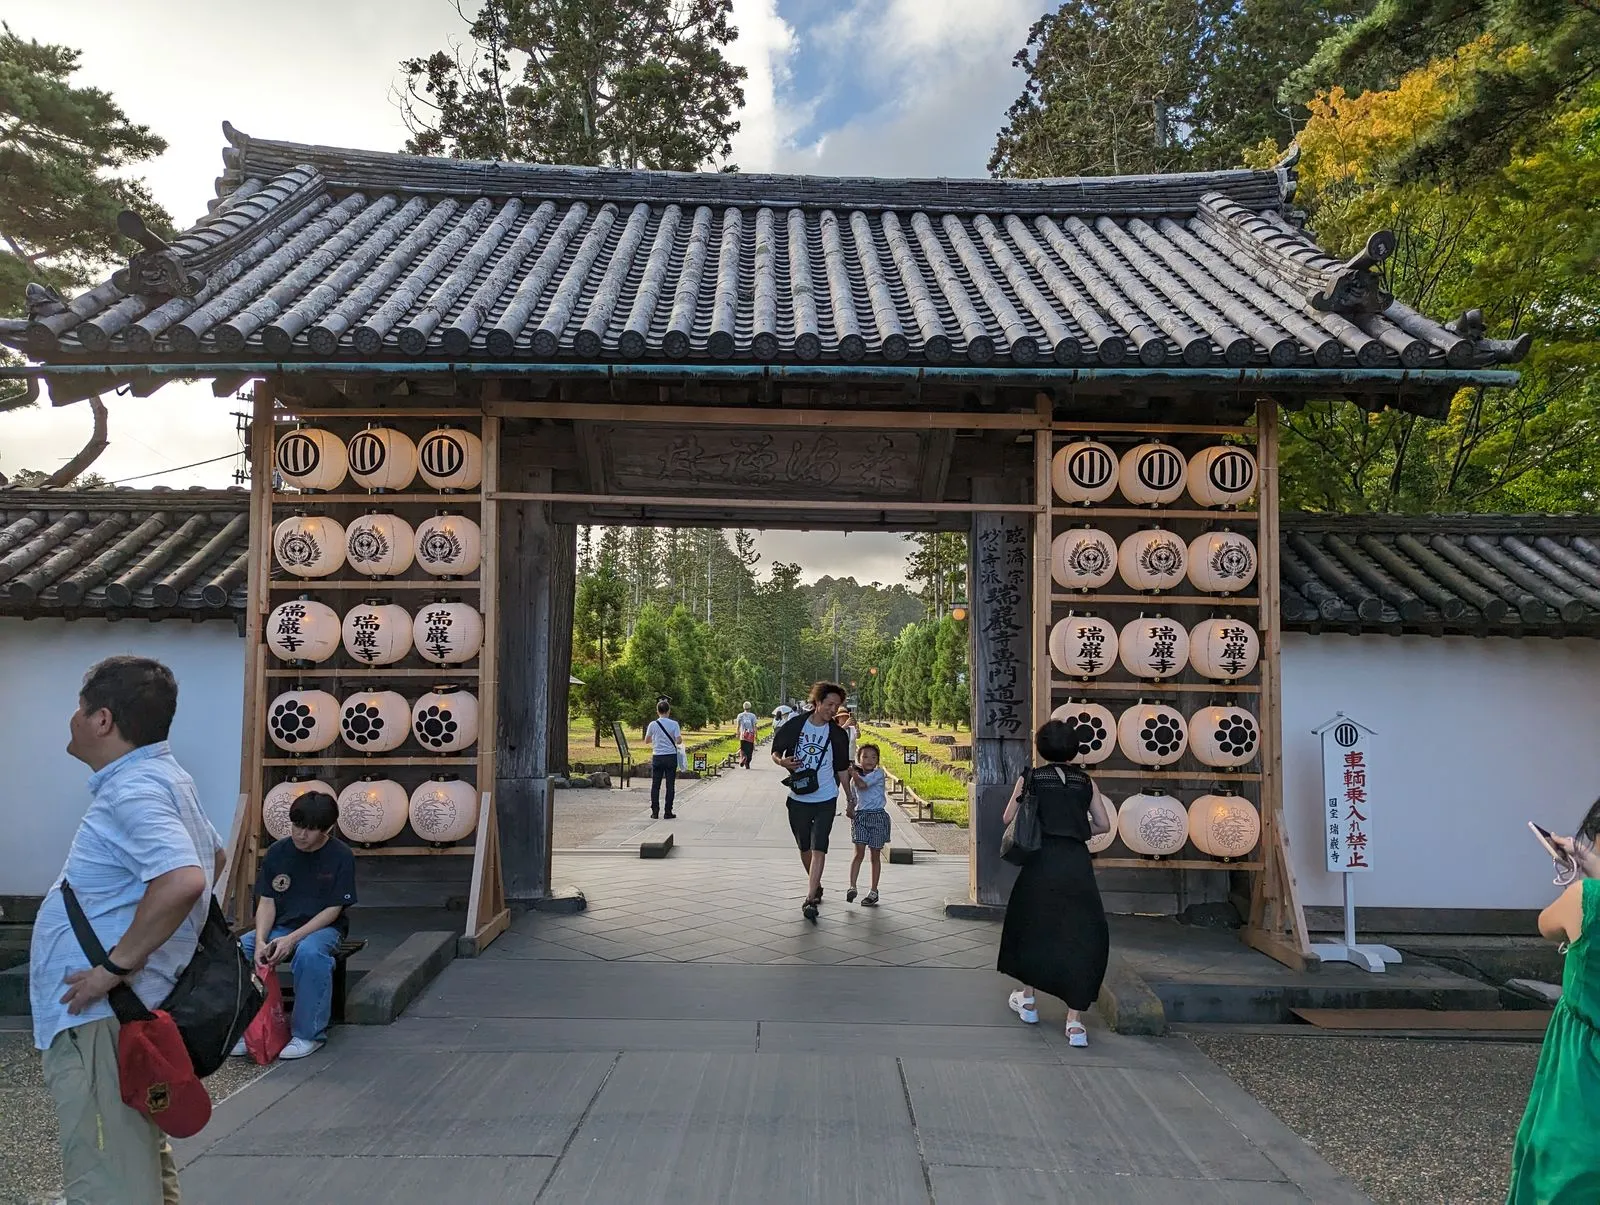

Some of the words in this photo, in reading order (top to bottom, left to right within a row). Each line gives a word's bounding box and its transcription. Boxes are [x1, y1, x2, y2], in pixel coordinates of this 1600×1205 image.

[979, 528, 1002, 585] 妙心寺派
[277, 604, 306, 652] 瑞巌寺
[352, 614, 381, 662] 瑞巌寺
[425, 610, 453, 659] 瑞巌寺
[1077, 626, 1105, 673] 瑞巌寺
[1148, 626, 1177, 673] 瑞巌寺
[1219, 627, 1248, 674] 瑞巌寺
[1328, 798, 1339, 819] 国宝
[1343, 750, 1368, 867] 車輌乗入れ禁止
